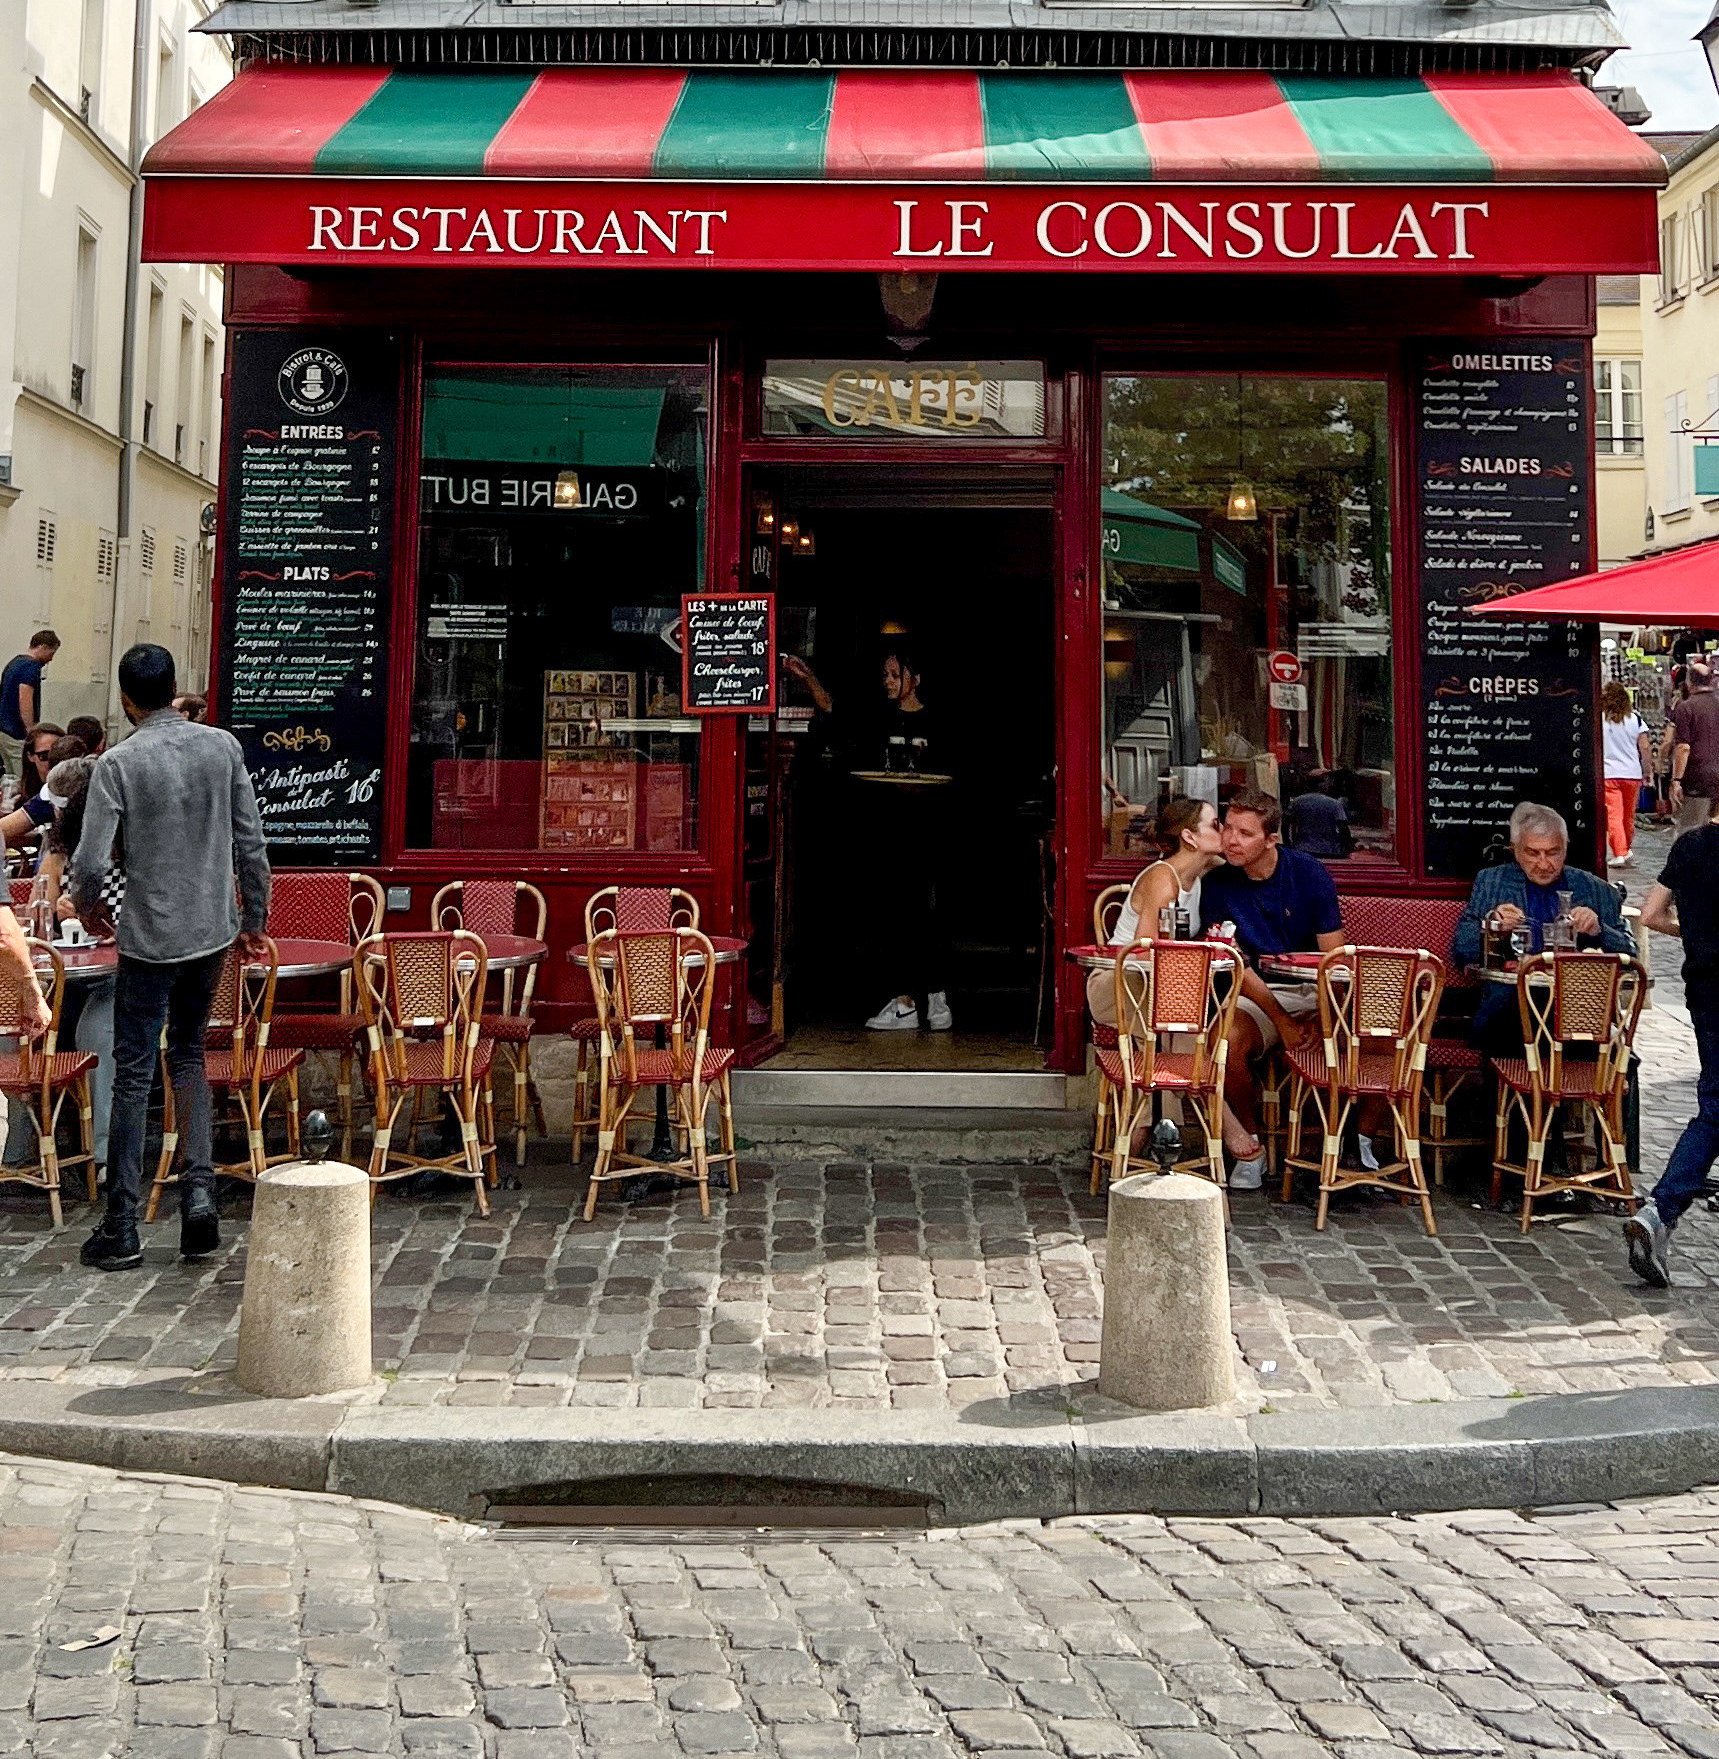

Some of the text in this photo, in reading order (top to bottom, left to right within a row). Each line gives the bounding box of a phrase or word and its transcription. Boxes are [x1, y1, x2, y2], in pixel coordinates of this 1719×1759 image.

[307, 205, 728, 255] RESTAURANT
[893, 200, 1489, 260] LE CONSULAT
[282, 351, 313, 377] Bistrot
[1452, 354, 1553, 371] OMELETTES
[820, 361, 983, 427] CAFÉ
[281, 425, 344, 440] ENTRÉES
[242, 461, 249, 470] 6
[288, 462, 300, 470] de
[303, 461, 352, 472] Bourgogne
[1460, 457, 1541, 475] SALADES
[290, 478, 301, 486] de
[283, 566, 330, 581] PLATS
[237, 587, 272, 598] Moules
[688, 601, 705, 612] LES
[708, 601, 718, 611] +
[738, 600, 768, 612] CARTE
[260, 622, 271, 631] de
[723, 616, 735, 627] de
[234, 654, 272, 665] Magret
[275, 654, 288, 663] de
[290, 654, 326, 664] canard
[264, 670, 277, 680] de
[280, 670, 316, 680] canard
[259, 687, 271, 696] de
[714, 677, 742, 692] frites
[1469, 675, 1539, 695] CRÊPES
[256, 788, 335, 816] Consulat
